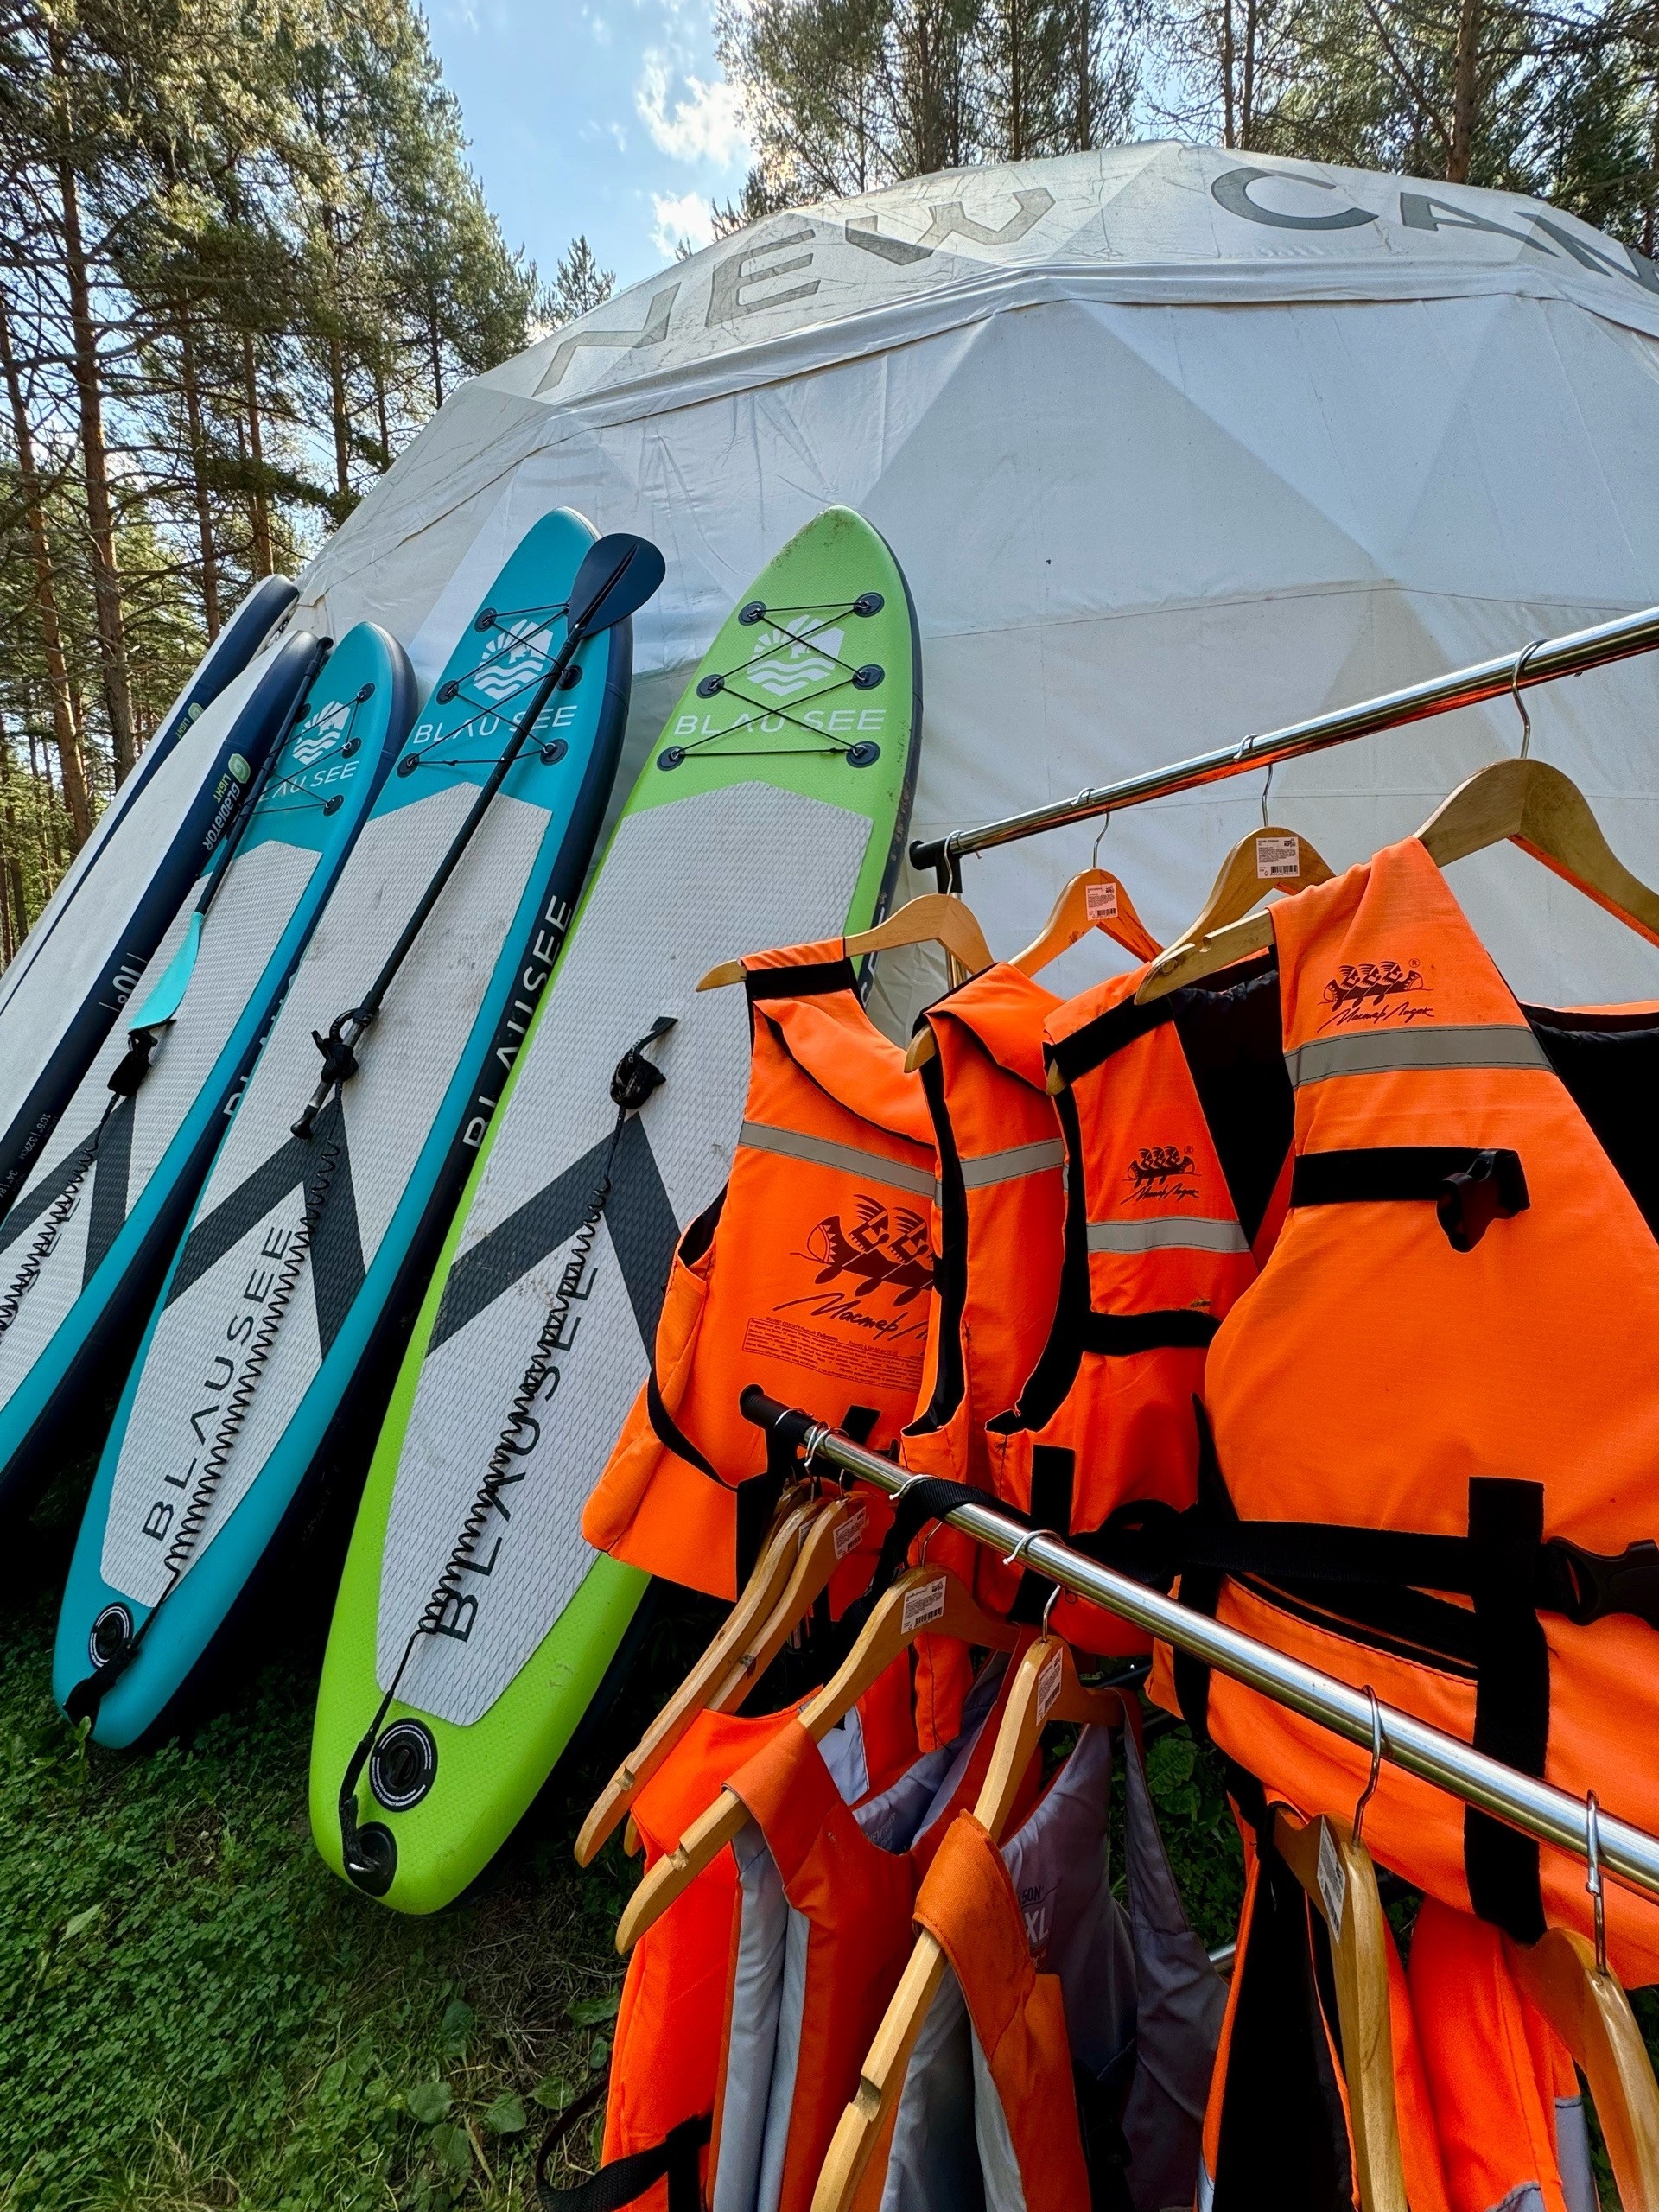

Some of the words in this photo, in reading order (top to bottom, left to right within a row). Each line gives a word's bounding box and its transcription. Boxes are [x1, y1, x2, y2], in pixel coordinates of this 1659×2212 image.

[532, 188, 1055, 397] NEW
[413, 716, 501, 744] BLAU
[674, 710, 785, 735] BLAU
[800, 709, 887, 731] SEE
[213, 773, 232, 804] LIGHT
[258, 774, 307, 803] LAU
[310, 760, 360, 787] SEE
[142, 1226, 293, 1542] BLAUSEE
